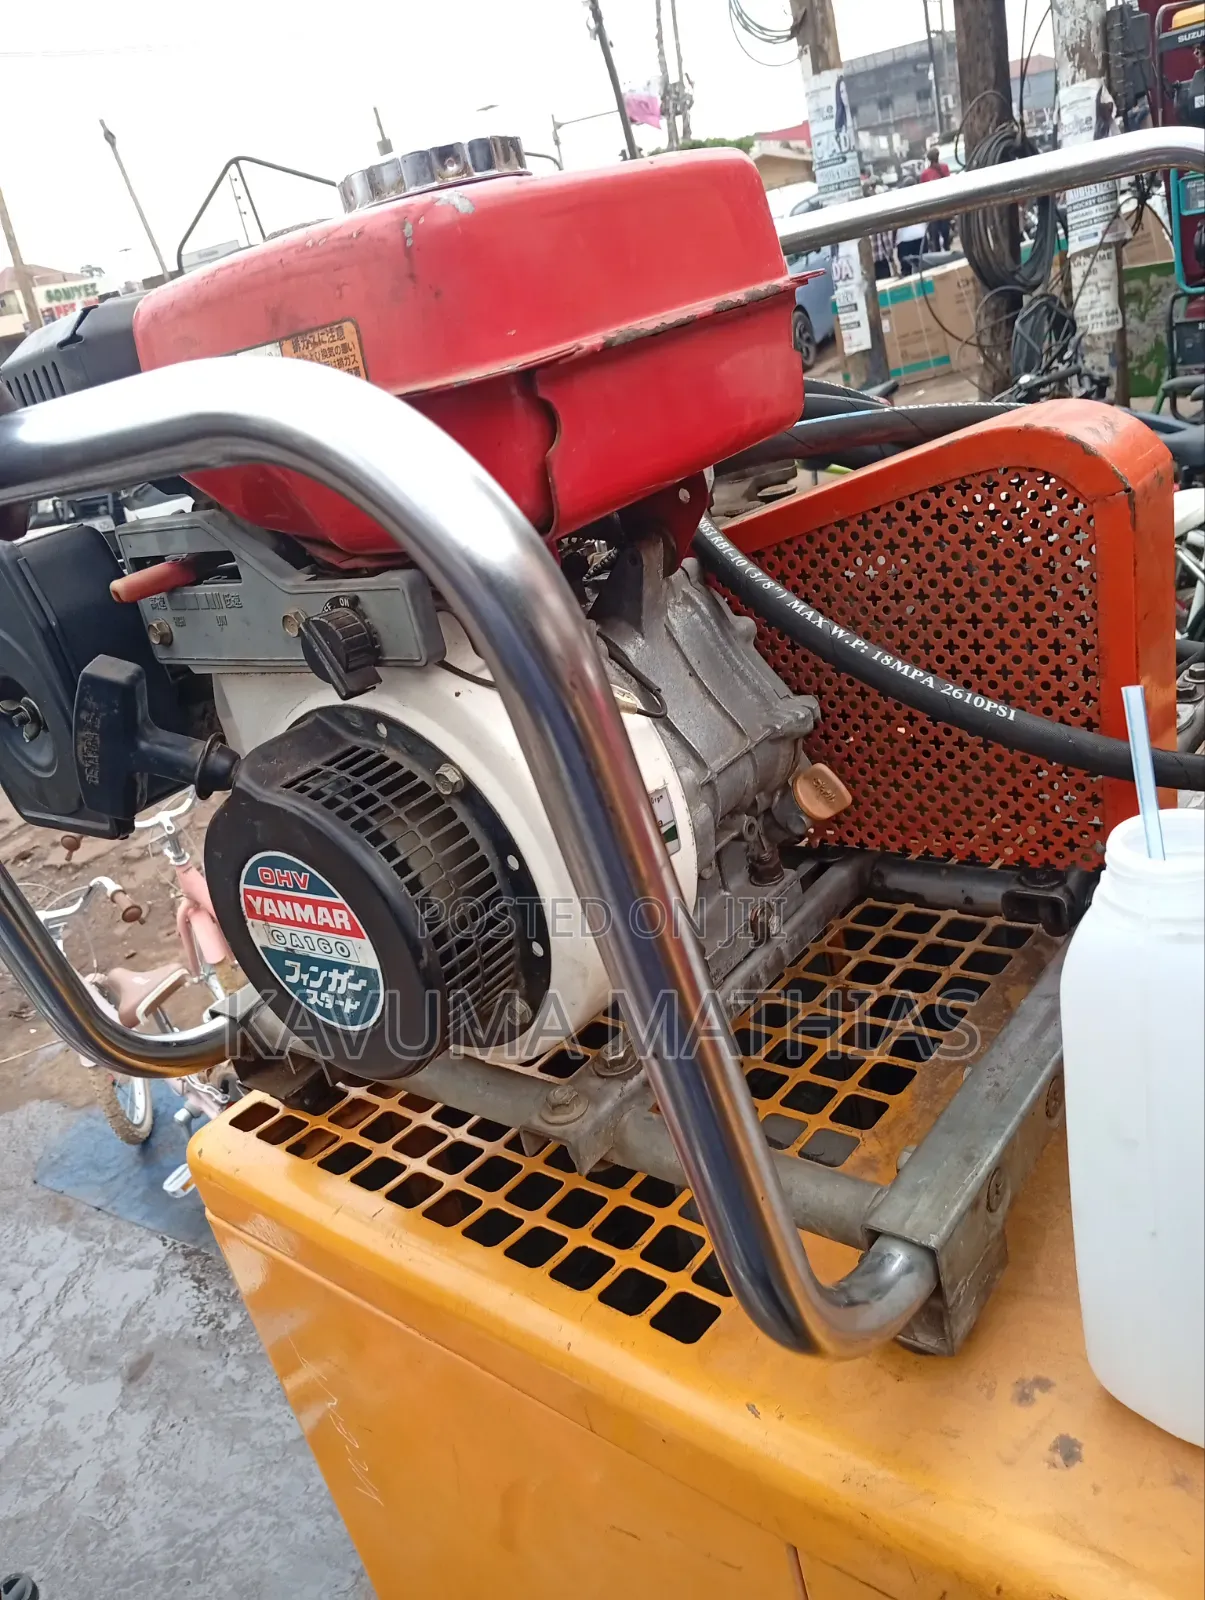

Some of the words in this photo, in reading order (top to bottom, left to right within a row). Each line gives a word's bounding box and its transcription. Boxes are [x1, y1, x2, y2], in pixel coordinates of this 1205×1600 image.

[339, 597, 350, 607] ON
[786, 600, 827, 629] MAX
[872, 650, 935, 689] 18MPA
[941, 684, 1017, 722] 2610PSI
[257, 866, 310, 891] OHV
[246, 894, 352, 932] YANMAR
[270, 929, 352, 958] GA160
[284, 959, 368, 995] フィンガー
[305, 988, 361, 1014] スタート
